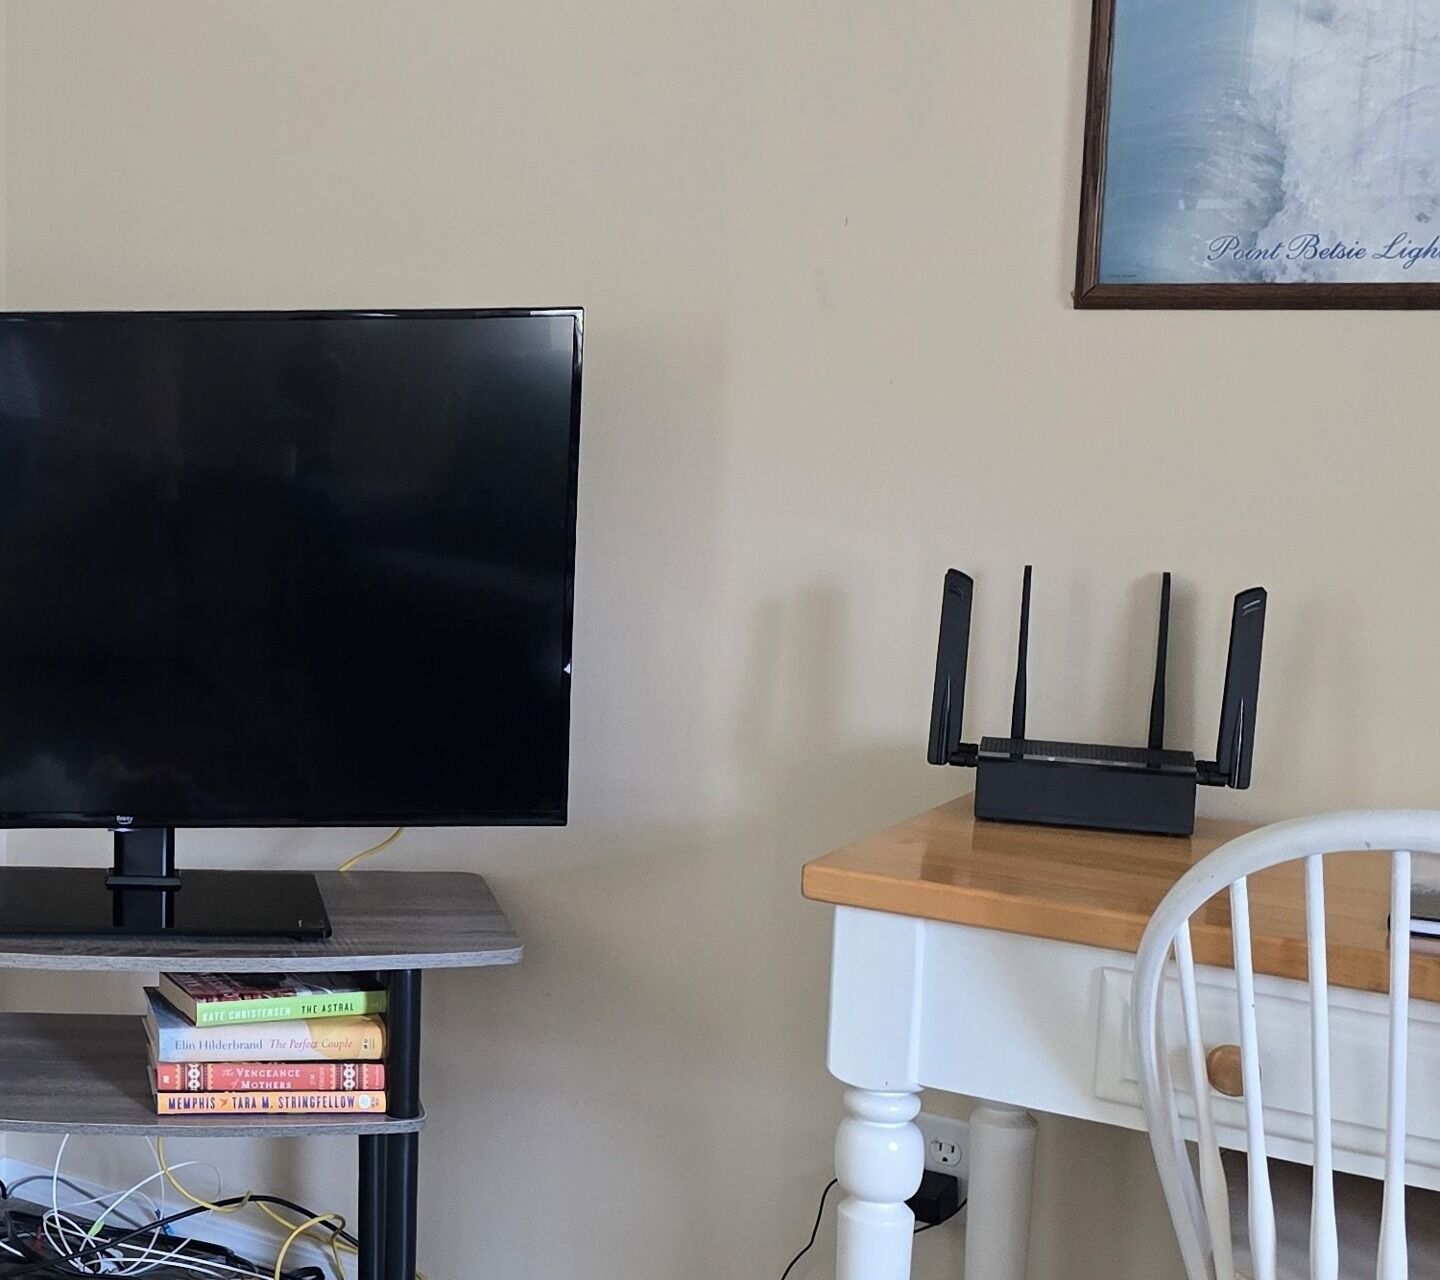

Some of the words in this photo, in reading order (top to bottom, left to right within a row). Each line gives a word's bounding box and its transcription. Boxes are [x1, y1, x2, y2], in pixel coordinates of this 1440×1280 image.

[1206, 233, 1284, 263] Point
[1285, 232, 1368, 262] Betsie
[202, 1010, 225, 1023] KATE
[229, 1005, 291, 1022] CHRISTENSEN
[301, 1004, 319, 1015] THE
[321, 1001, 355, 1014] ASTRAL
[174, 1039, 196, 1051] Elin
[198, 1038, 263, 1051] Hilderbrand
[269, 1038, 287, 1050] The
[288, 1038, 319, 1050] Perfect
[321, 1037, 353, 1052] Couple
[236, 1067, 301, 1079] VENGEANCE
[240, 1079, 292, 1090] MOTHERS
[168, 1096, 216, 1110] MEMPHIS
[232, 1096, 257, 1110] TARA
[262, 1096, 274, 1110] M.
[278, 1095, 355, 1109] STRINGFELLOW
